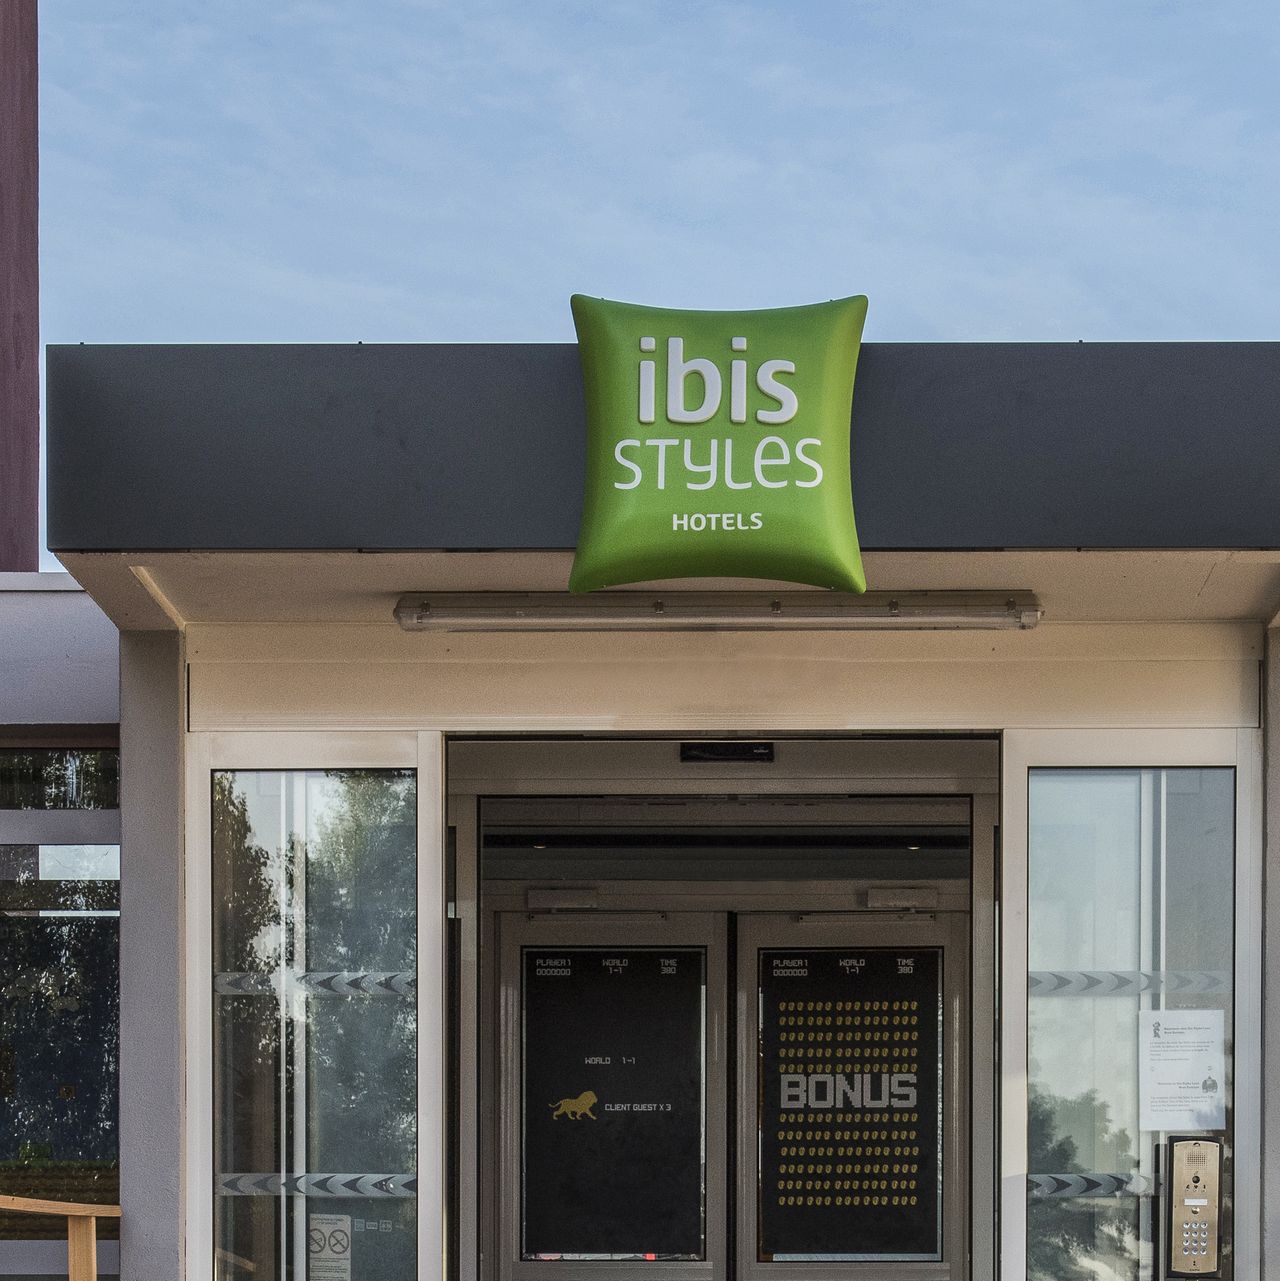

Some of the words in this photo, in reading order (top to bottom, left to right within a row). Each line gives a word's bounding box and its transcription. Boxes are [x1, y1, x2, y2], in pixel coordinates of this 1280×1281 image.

[638, 336, 799, 424] ibis
[671, 512, 763, 531] HOTELS
[536, 958, 566, 967] PLAYER
[602, 958, 629, 967] WORLD
[660, 958, 677, 967] TIME
[773, 959, 803, 967] PLAYER
[839, 959, 865, 967] WORLD
[896, 958, 915, 966] TIME
[584, 1057, 611, 1065] WORLD
[622, 1056, 636, 1064] 1-1
[780, 1073, 917, 1109] BONUS
[604, 1103, 631, 1111] CLIENT
[632, 1103, 657, 1111] GUEST
[666, 1103, 672, 1111] 3
